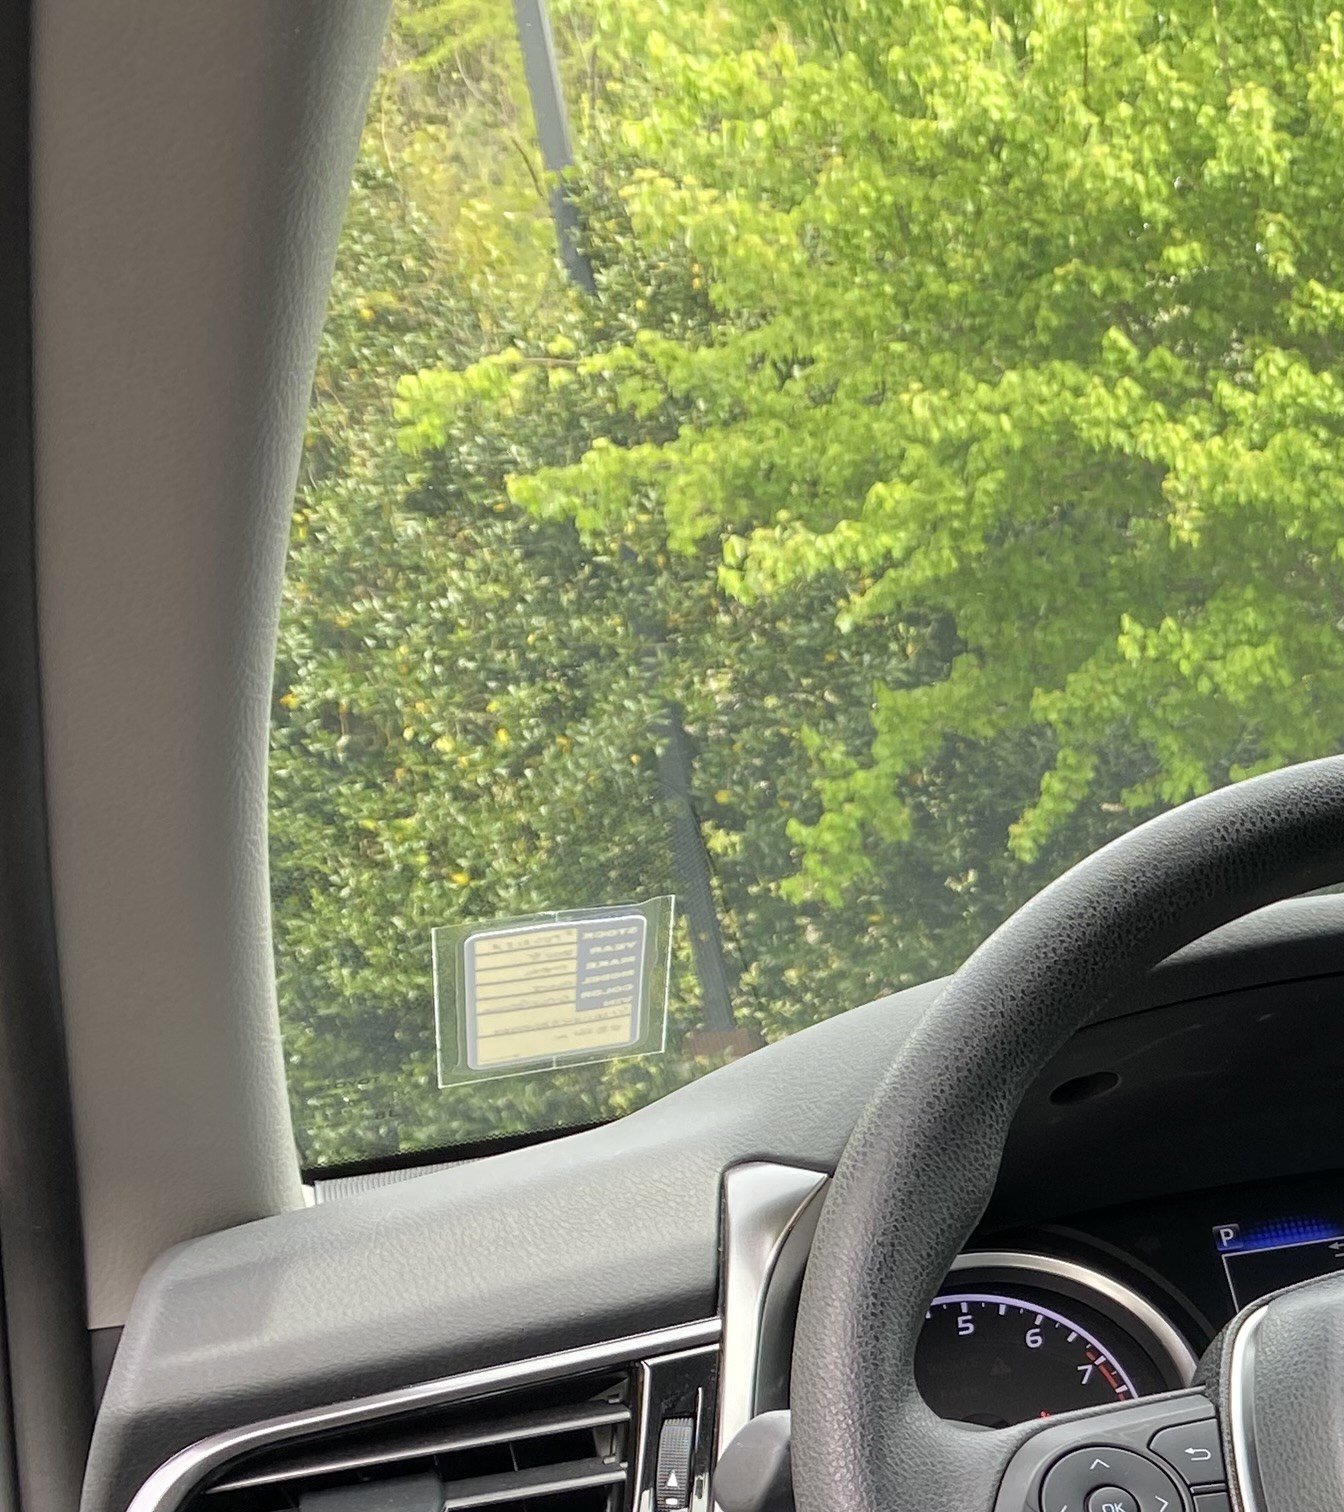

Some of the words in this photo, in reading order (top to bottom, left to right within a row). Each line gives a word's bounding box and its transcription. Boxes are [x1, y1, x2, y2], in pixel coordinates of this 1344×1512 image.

[1219, 1228, 1235, 1248] P
[957, 1315, 975, 1336] 5
[1025, 1328, 1043, 1349] 6
[1077, 1363, 1093, 1385] 7
